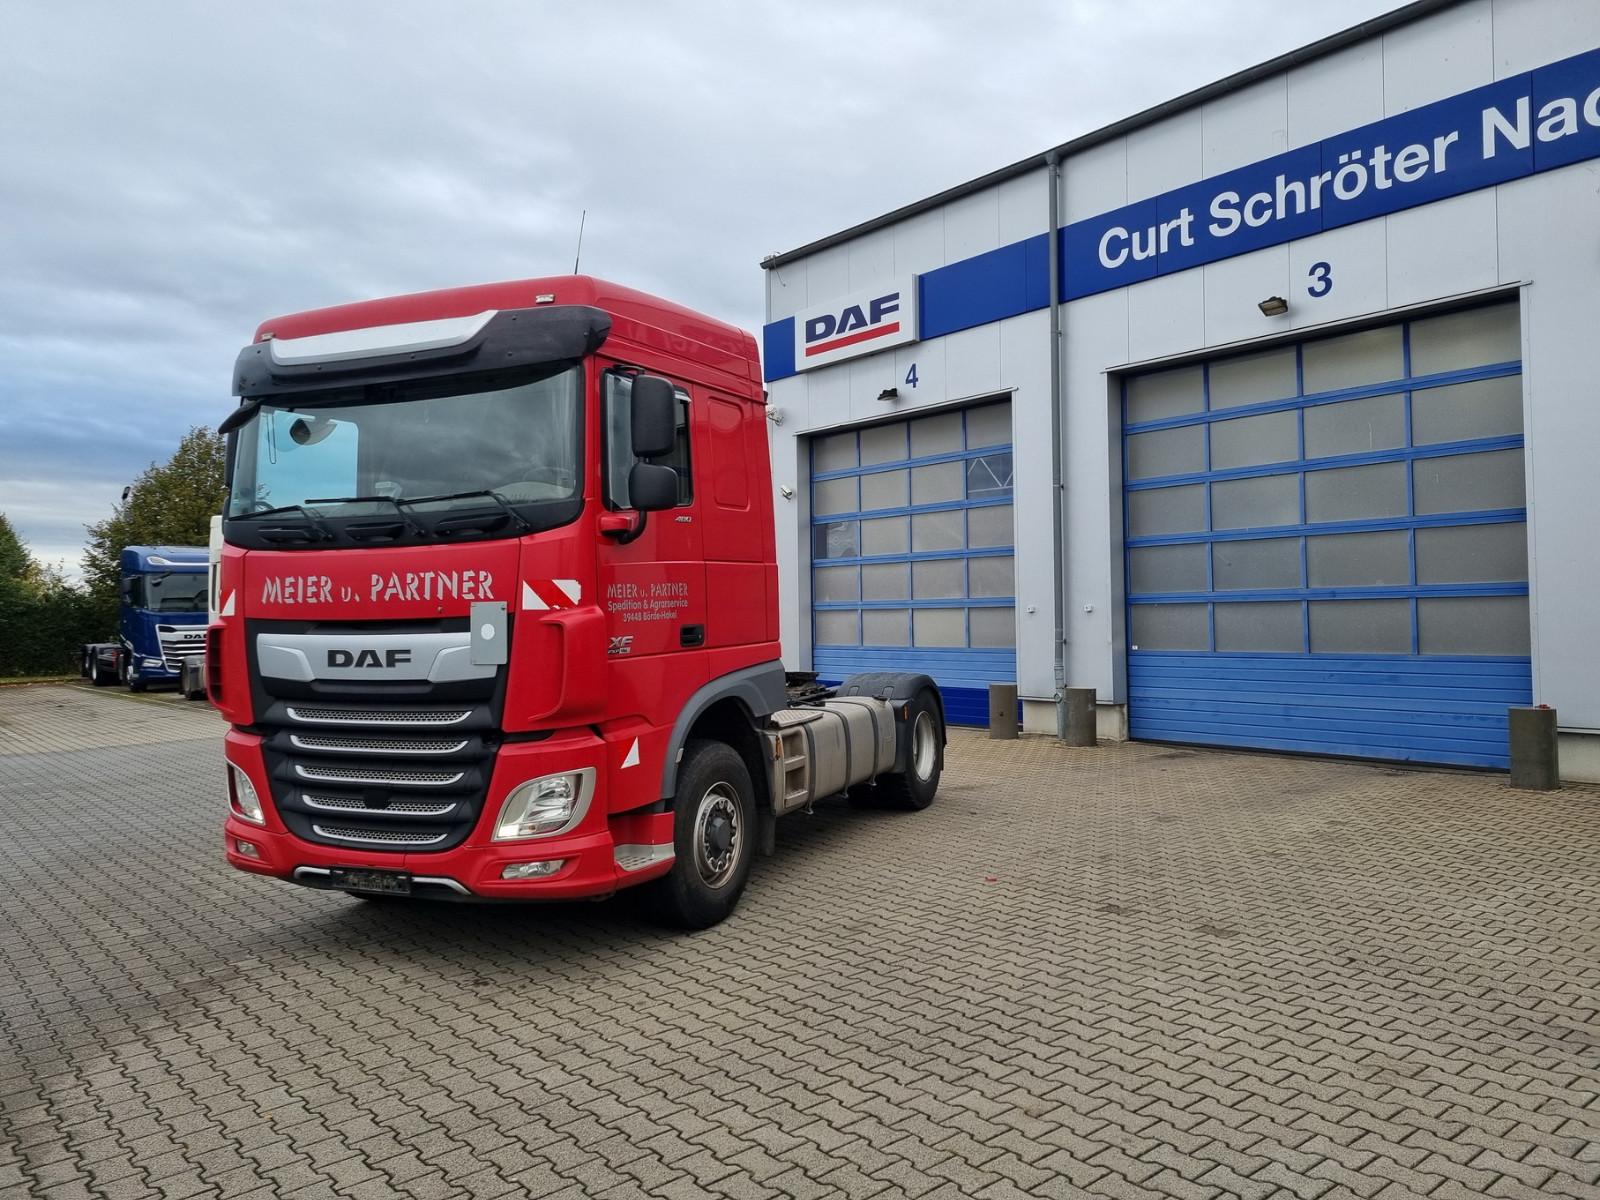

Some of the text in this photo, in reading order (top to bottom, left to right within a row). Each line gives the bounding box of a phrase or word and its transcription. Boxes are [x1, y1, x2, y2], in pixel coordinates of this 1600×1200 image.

[1098, 208, 1194, 269] Curt
[1209, 130, 1459, 238] Schröter
[1307, 261, 1333, 298] 3
[805, 291, 900, 344] DAF
[905, 363, 919, 388] 4
[261, 575, 333, 604] MEIER
[370, 569, 494, 601] PARTNER
[607, 583, 638, 598] MEIER
[650, 582, 688, 597] PARTNER
[607, 598, 688, 613] Spedition & Agrarservice
[608, 635, 634, 649] XF
[327, 649, 412, 668] DAF
